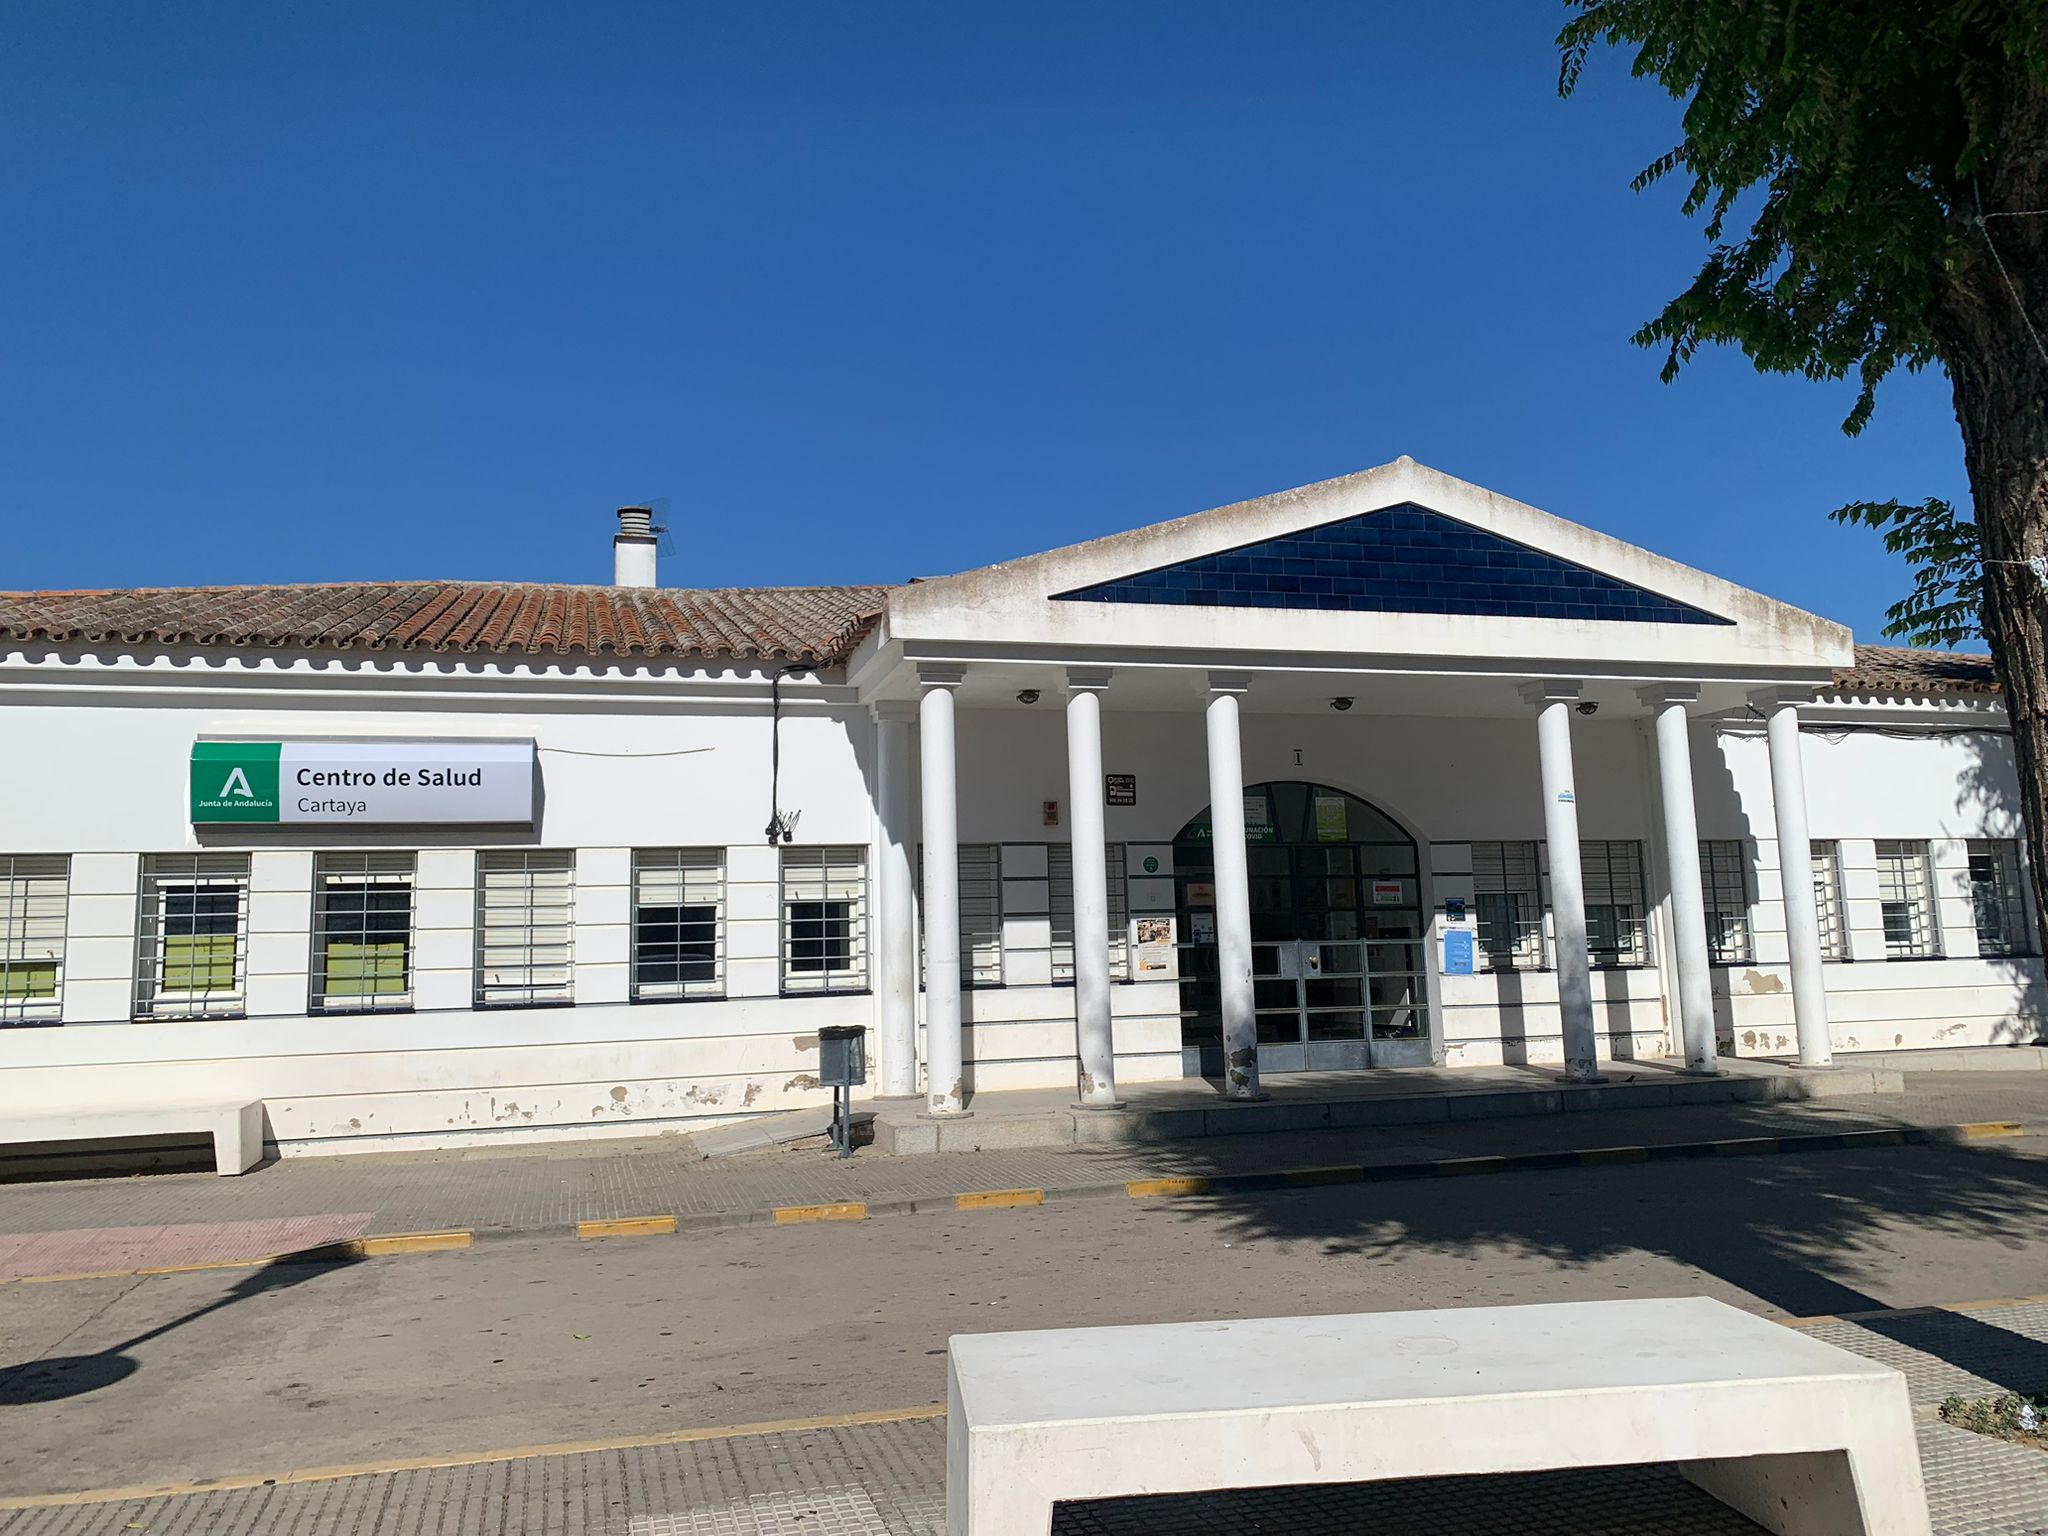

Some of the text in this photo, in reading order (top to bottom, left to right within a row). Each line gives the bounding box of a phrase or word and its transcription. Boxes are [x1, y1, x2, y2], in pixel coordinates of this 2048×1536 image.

[296, 768, 482, 787] Centro de Salud
[222, 799, 233, 807] de
[233, 799, 273, 807] Andalucía
[298, 797, 367, 816] Cartaya
[1245, 825, 1274, 834] UNACIÓN
